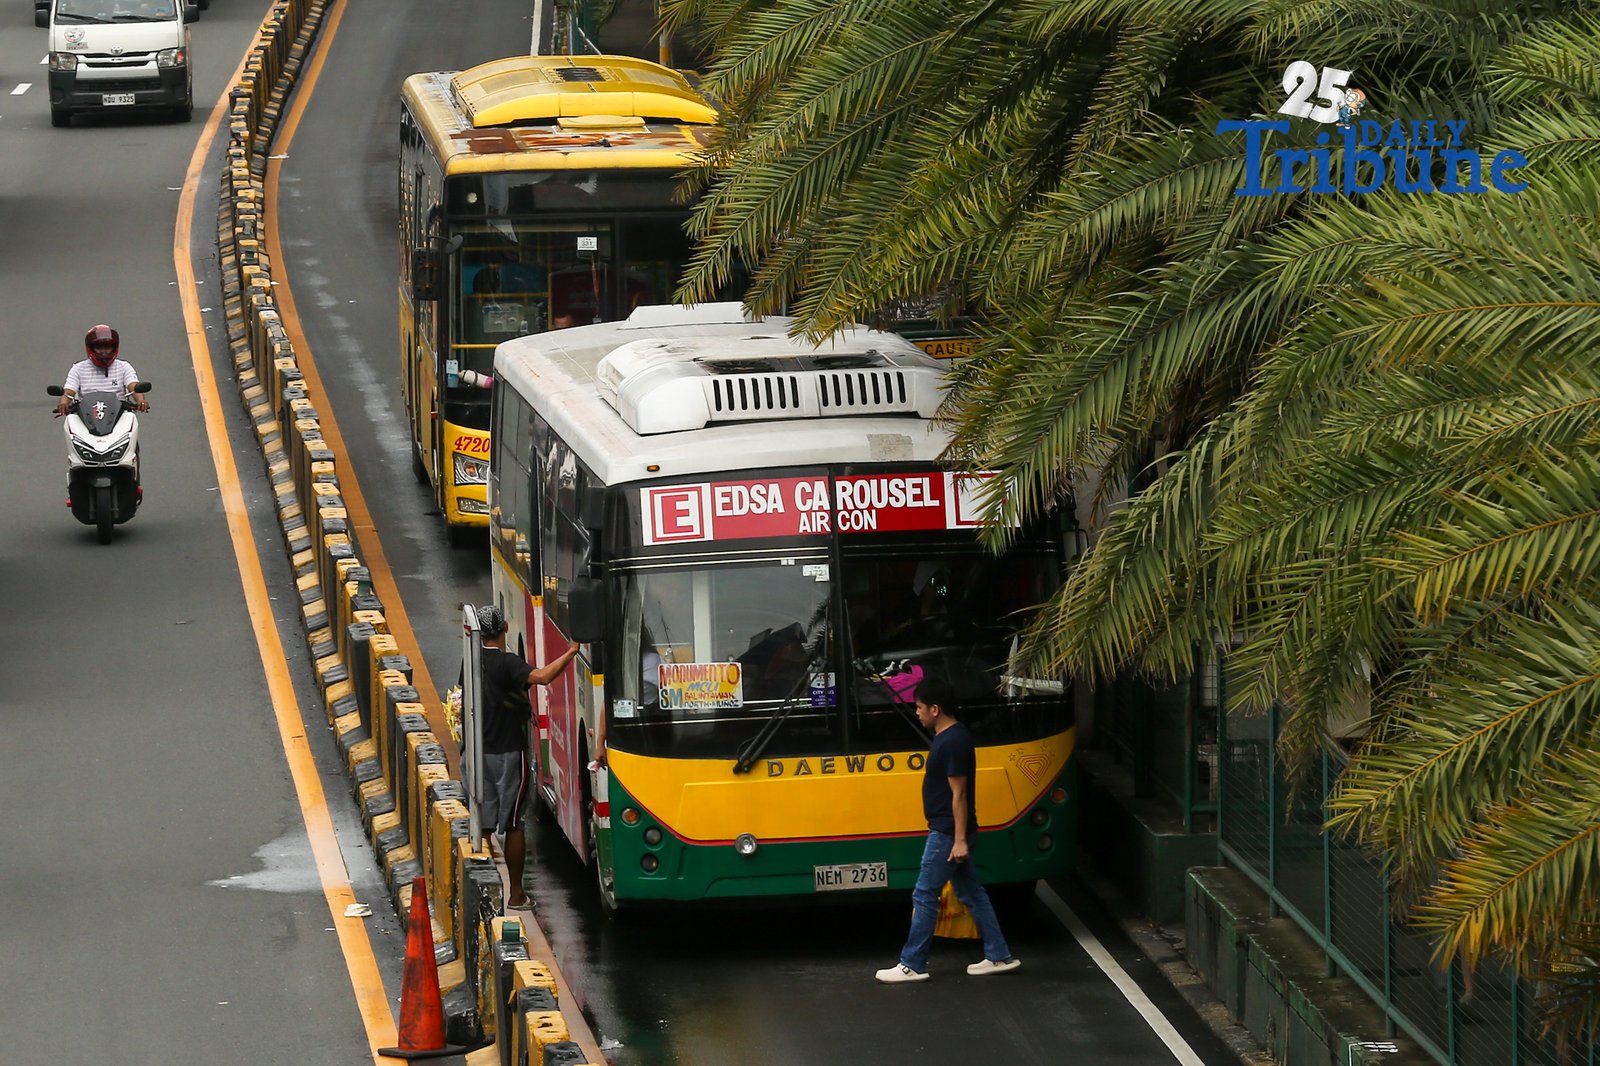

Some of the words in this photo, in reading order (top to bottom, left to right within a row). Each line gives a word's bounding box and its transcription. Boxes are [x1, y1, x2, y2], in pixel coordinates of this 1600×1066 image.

[118, 95, 134, 103] 9325
[454, 436, 490, 452] 4720
[714, 483, 785, 517] EDSA
[794, 476, 940, 512] CAROUSEL
[660, 688, 683, 708] SM
[767, 753, 925, 777] DAEWOO
[816, 870, 843, 886] NEM
[851, 867, 886, 884] 2736
